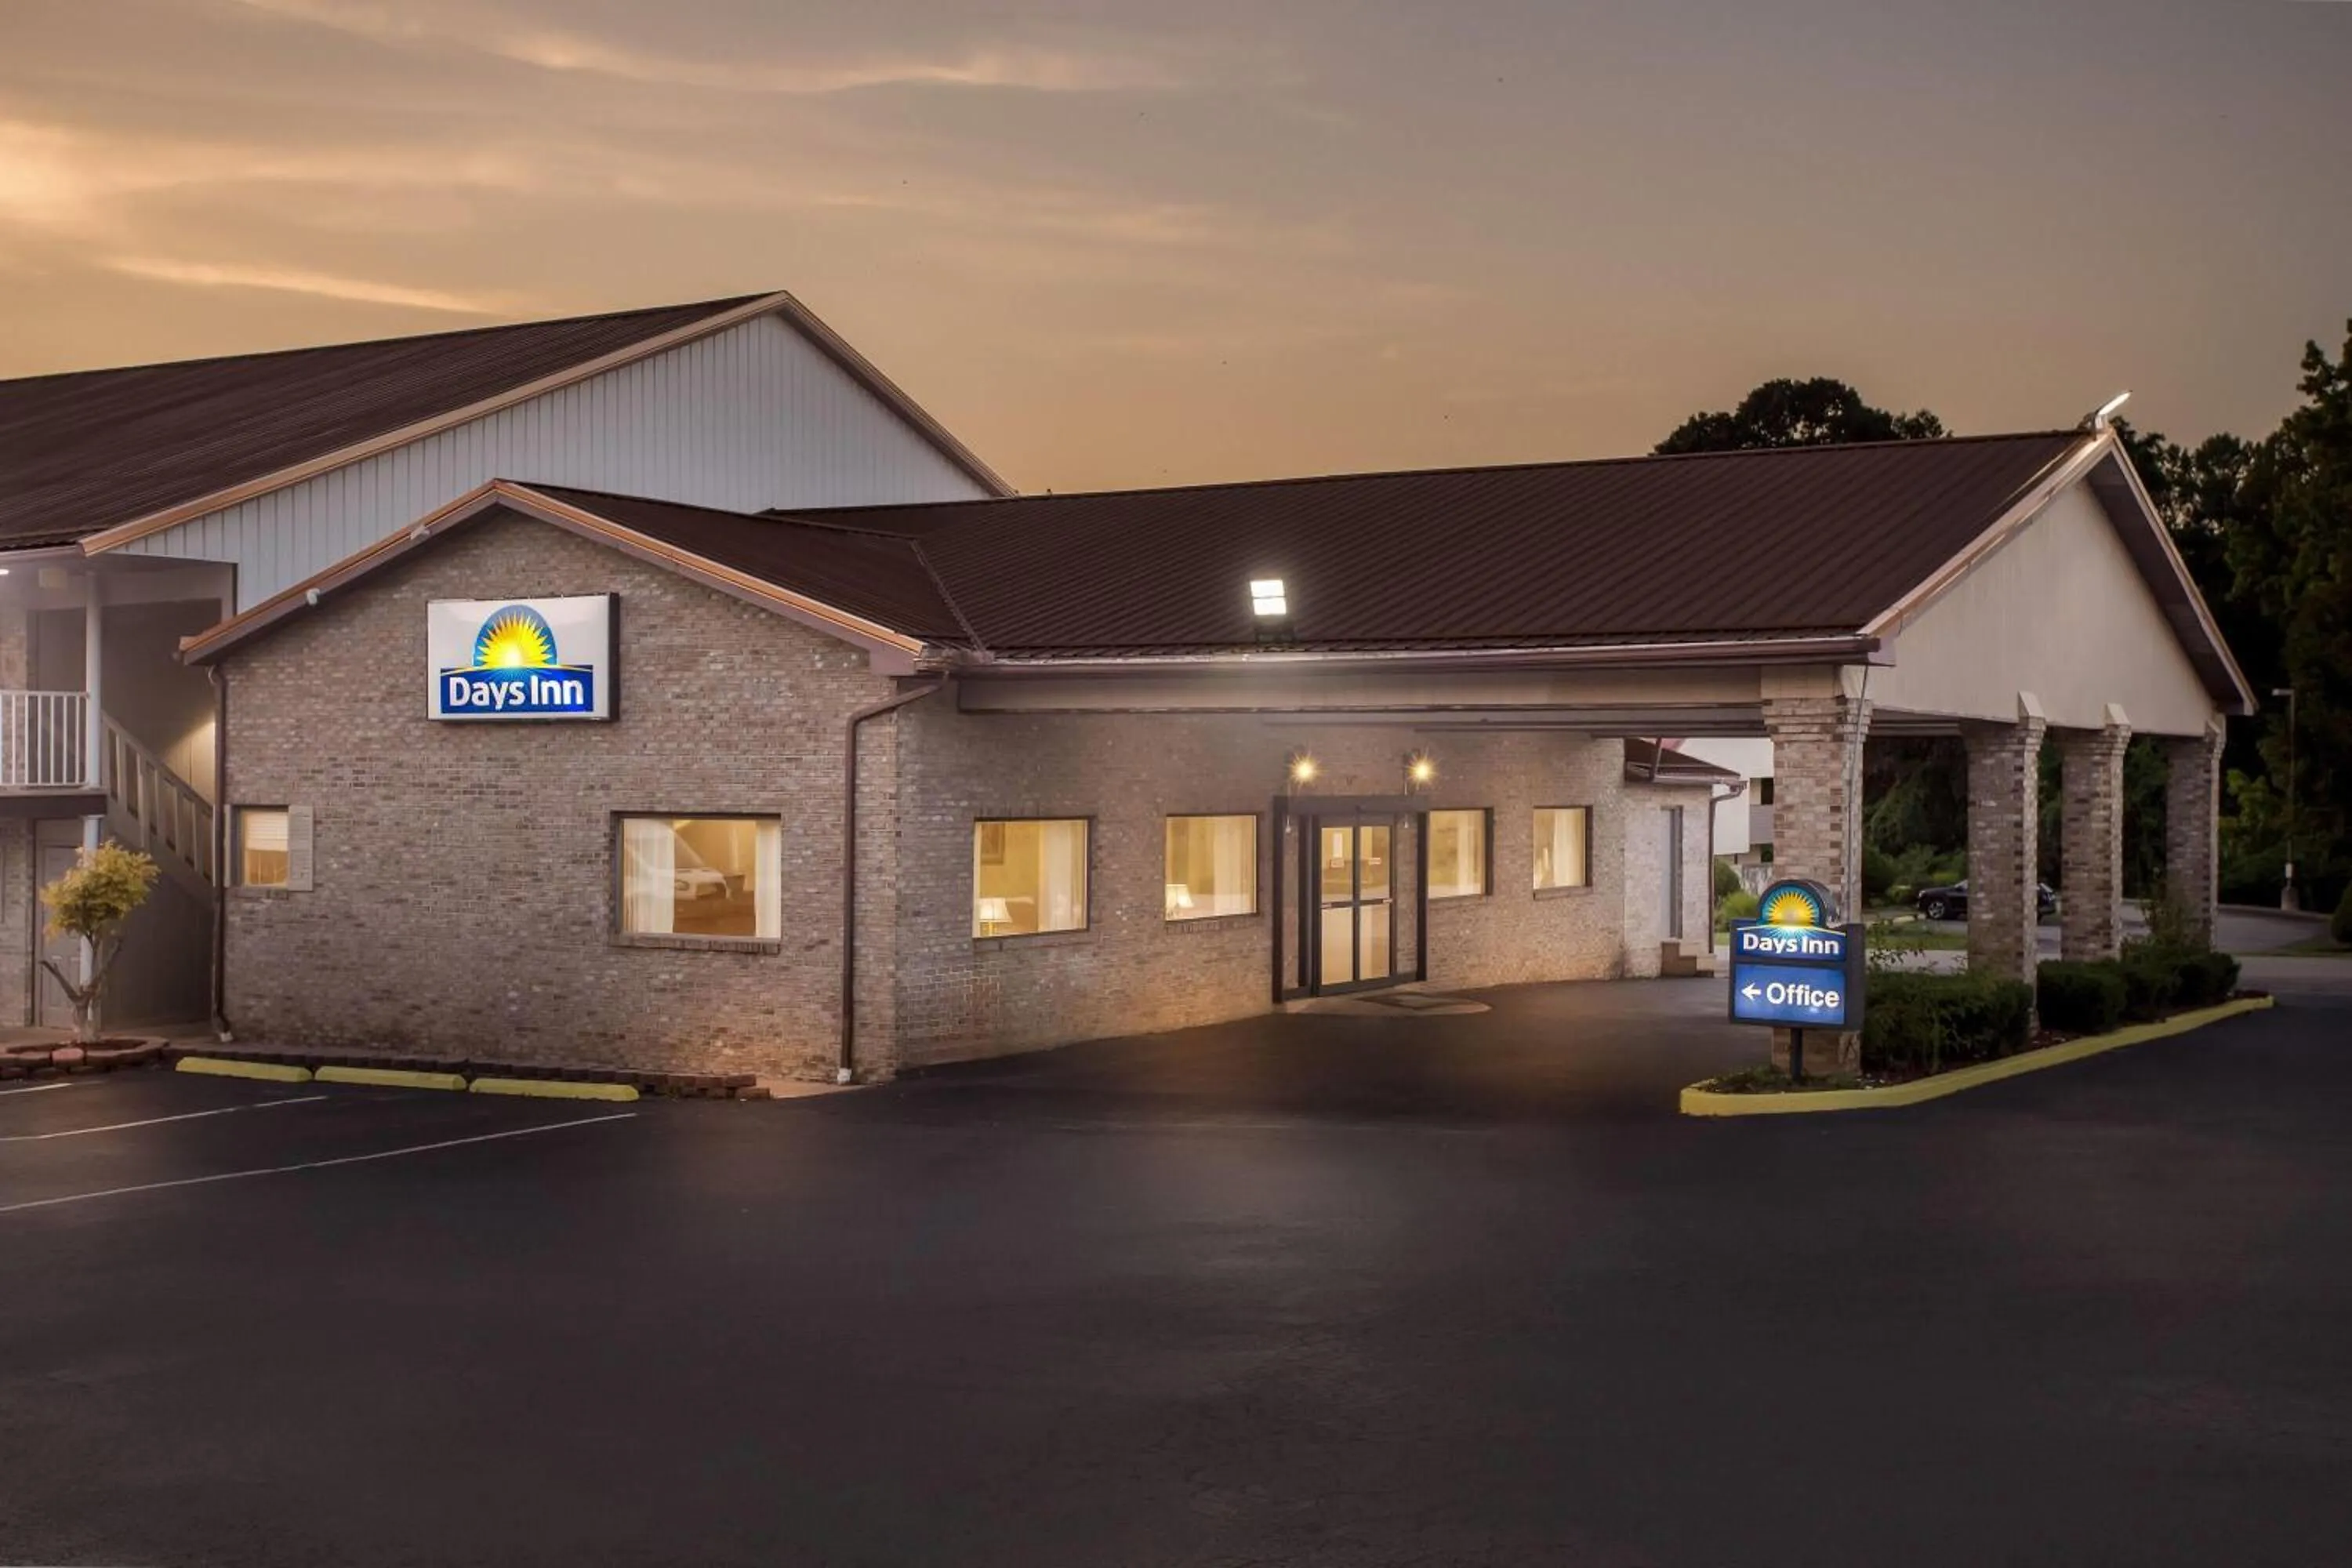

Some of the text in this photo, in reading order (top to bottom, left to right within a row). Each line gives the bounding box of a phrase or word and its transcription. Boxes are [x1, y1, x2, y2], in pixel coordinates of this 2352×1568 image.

[449, 676, 584, 711] Days Inn
[1743, 933, 1839, 955] Days Inn
[1766, 982, 1841, 1008] Office
